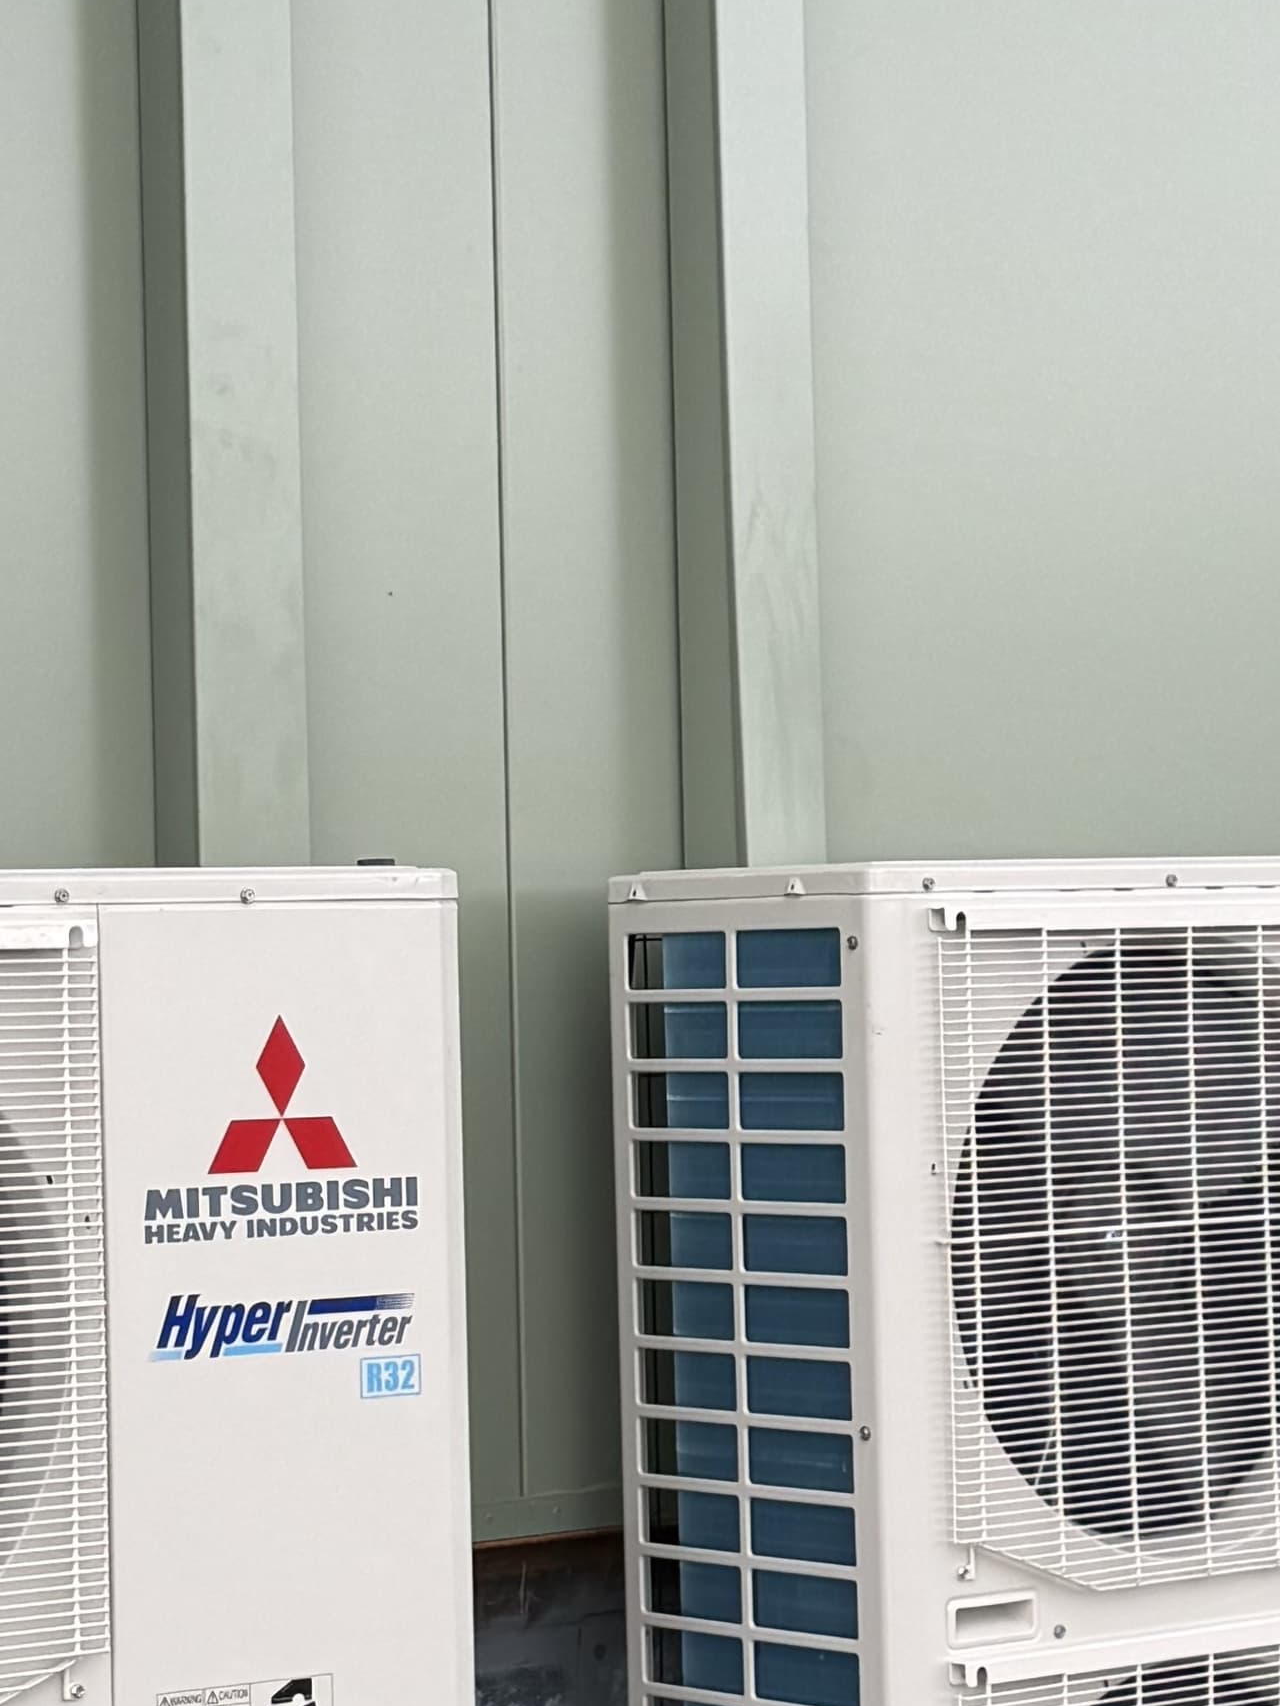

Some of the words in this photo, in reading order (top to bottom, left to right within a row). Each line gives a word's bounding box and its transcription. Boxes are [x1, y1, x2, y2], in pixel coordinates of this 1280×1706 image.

[144, 1177, 418, 1221] MITSUBISHI
[144, 1220, 237, 1244] HEAVY
[247, 1210, 419, 1238] INDUSTRIES
[156, 1293, 293, 1360] Hyper
[285, 1300, 413, 1353] Inverter
[366, 1359, 415, 1393] R32
